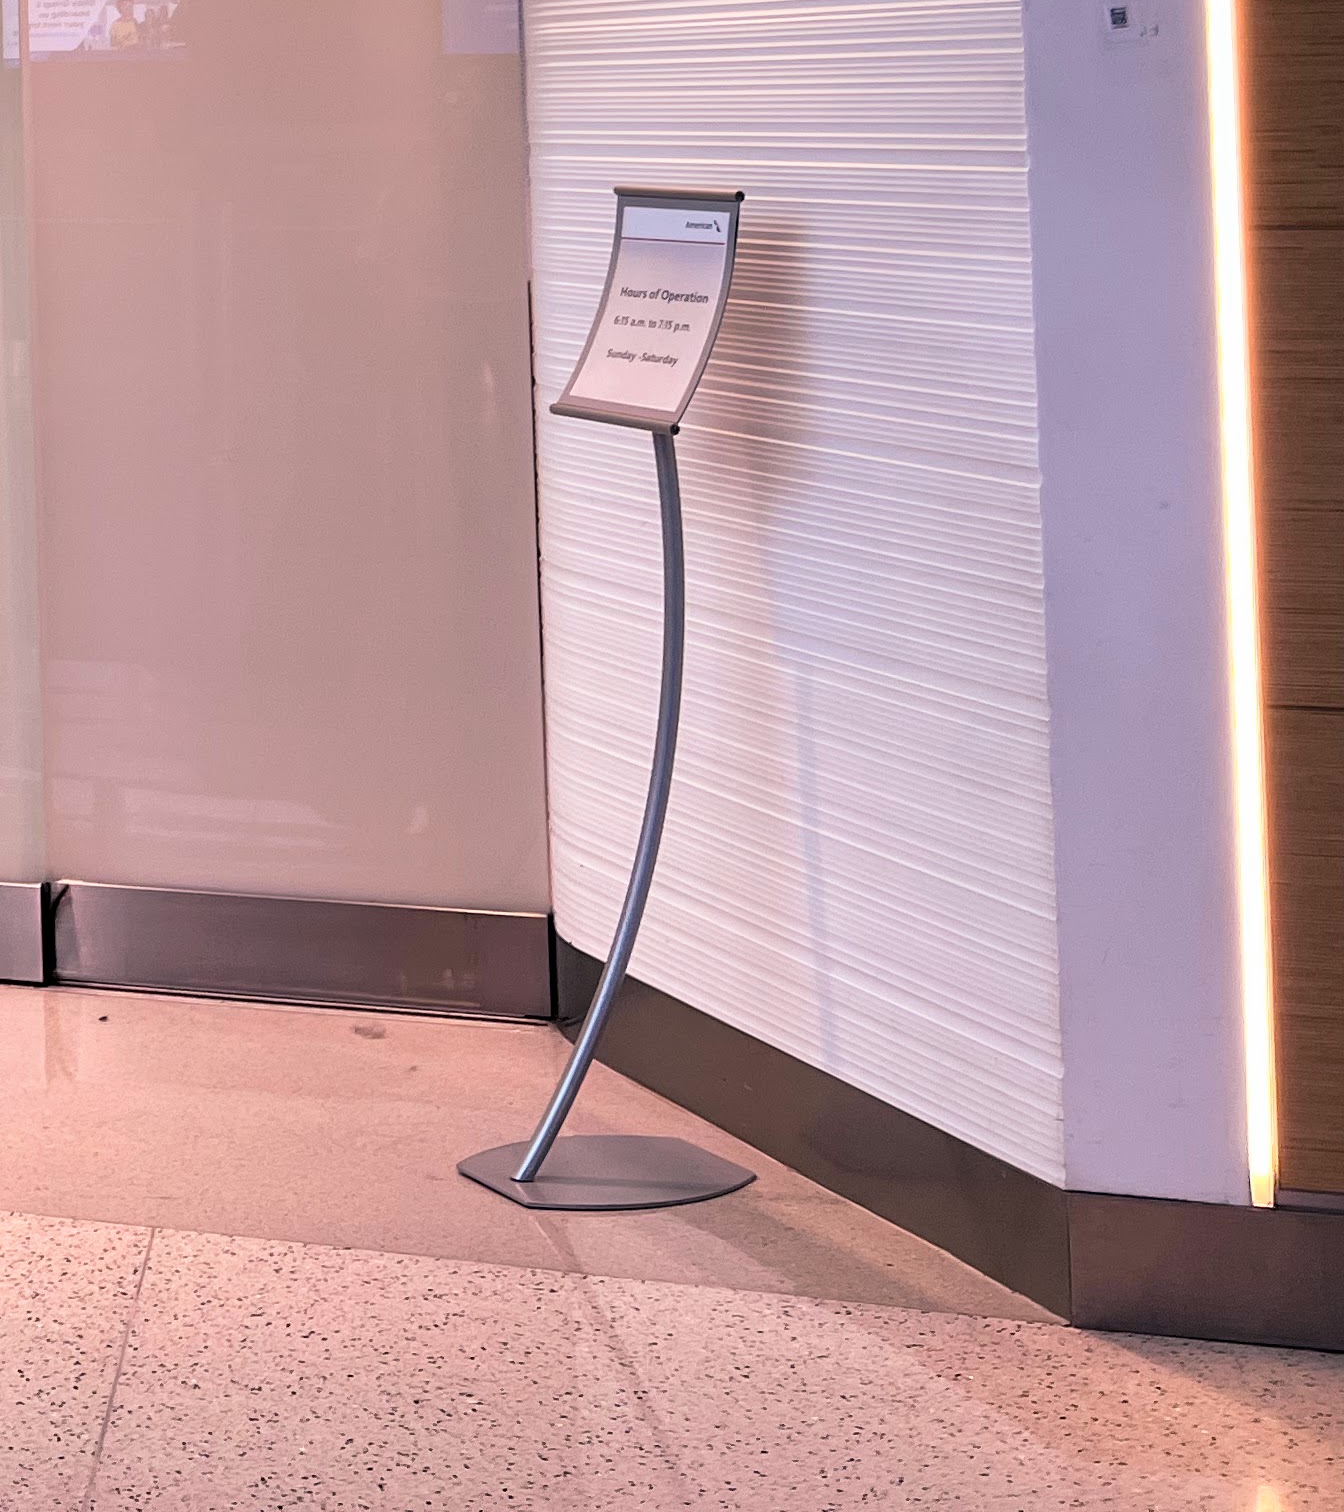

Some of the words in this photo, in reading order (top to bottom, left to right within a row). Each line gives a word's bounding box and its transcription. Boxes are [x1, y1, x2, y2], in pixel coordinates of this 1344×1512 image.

[620, 287, 648, 299] Hours
[648, 288, 662, 300] of
[660, 290, 709, 304] Operation
[648, 319, 657, 328] to
[606, 348, 637, 363] Sunday
